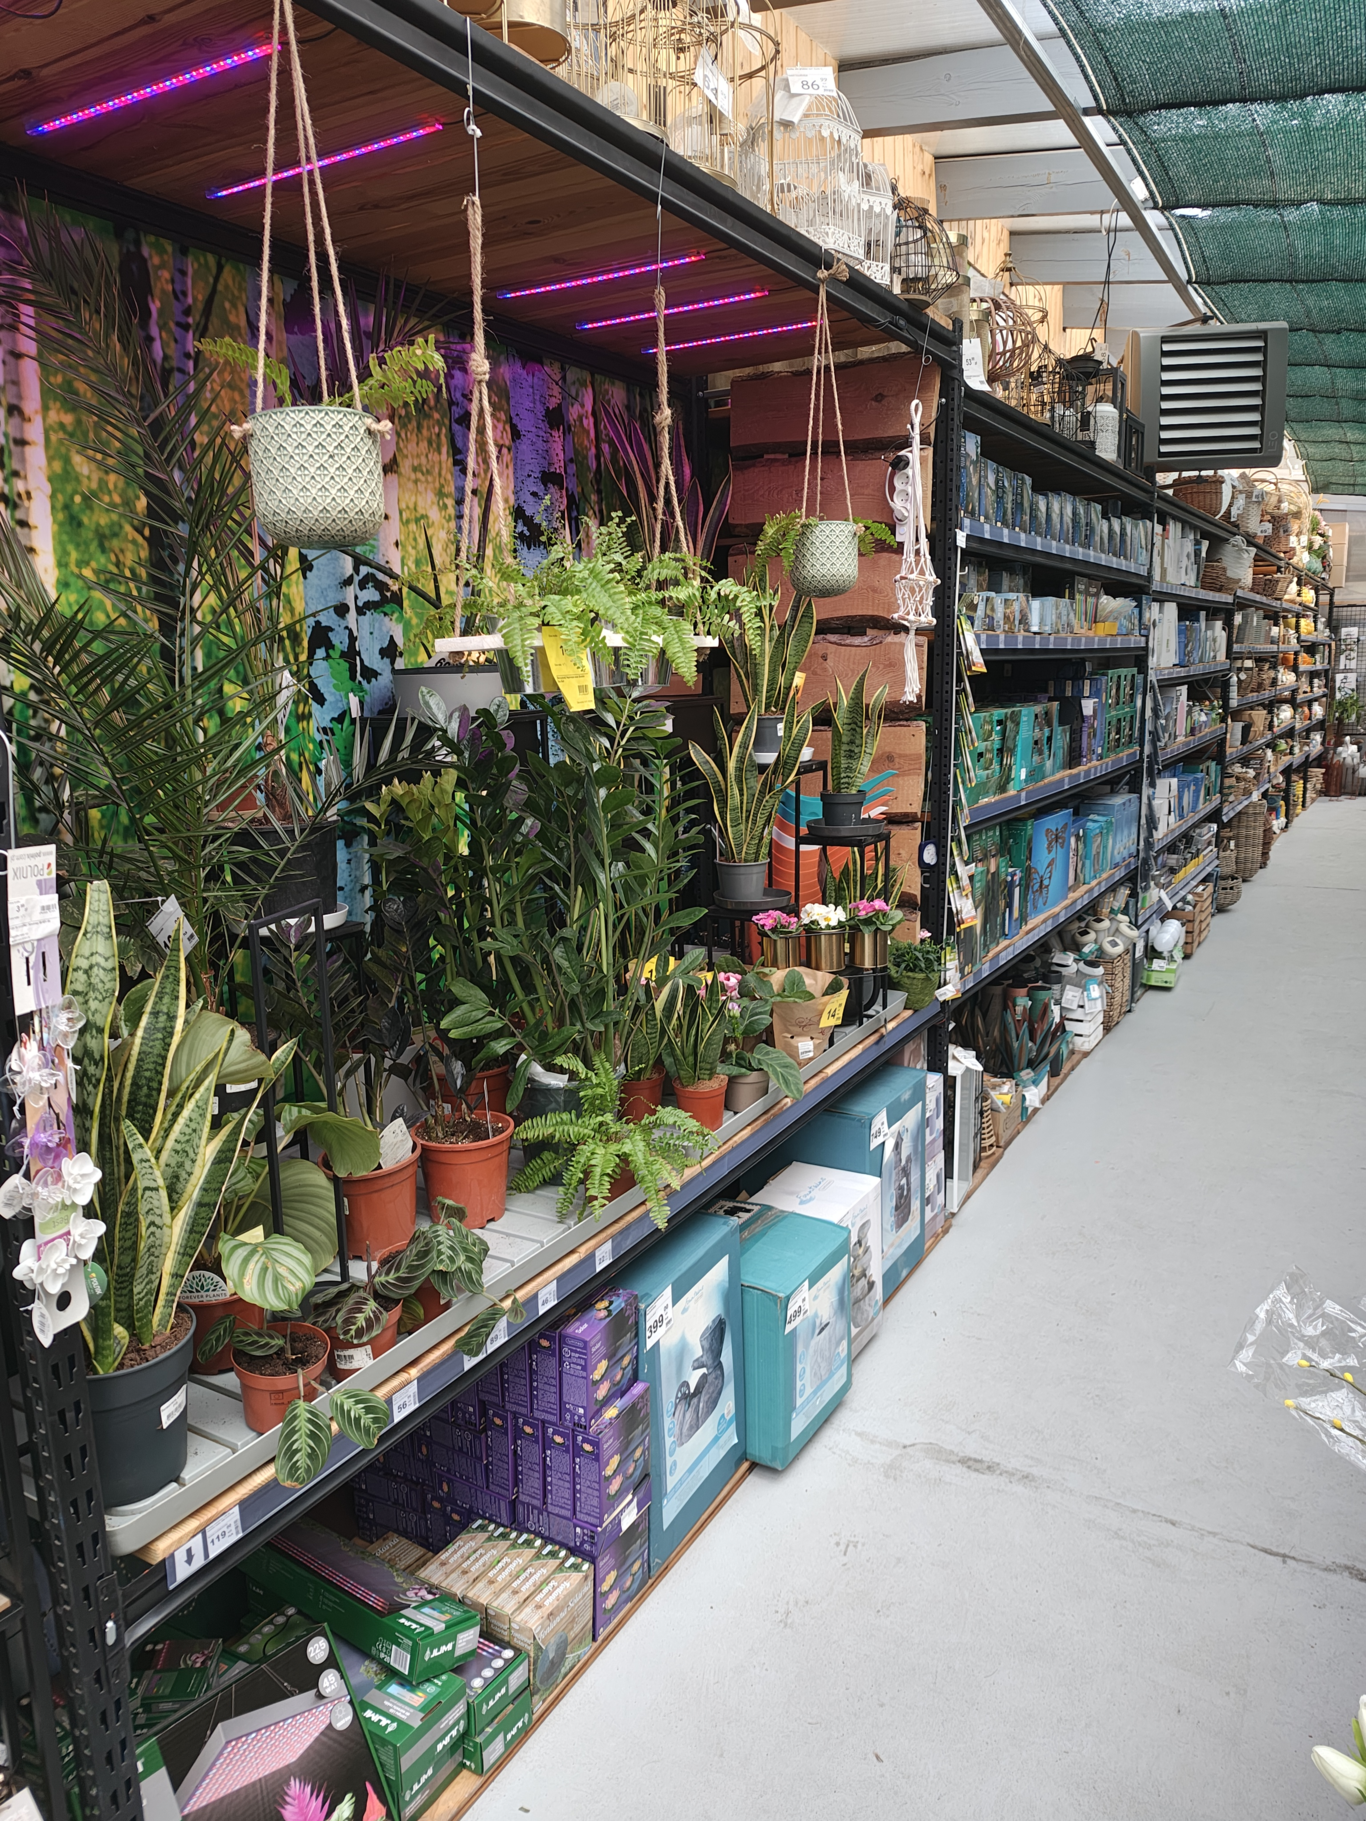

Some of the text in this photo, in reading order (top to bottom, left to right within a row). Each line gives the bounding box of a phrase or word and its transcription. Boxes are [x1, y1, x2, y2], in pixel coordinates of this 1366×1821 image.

[800, 79, 821, 91] 86
[1268, 430, 1279, 451] LEO
[12, 863, 45, 881] POLNIX
[826, 1007, 838, 1021] 14
[52, 1214, 69, 1230] Best
[786, 1304, 802, 1326] 499
[647, 1313, 664, 1339] 399
[489, 1333, 499, 1346] 89
[397, 1401, 408, 1414] 56
[209, 1530, 227, 1546] 119
[375, 1537, 400, 1556] olarna
[487, 1556, 511, 1578] Solarna
[496, 1556, 524, 1582] Fontanna
[511, 1566, 535, 1588] Solarna
[520, 1567, 548, 1593] Fontanna
[534, 1580, 558, 1602] Solarna
[543, 1581, 571, 1607] Fontanna
[308, 1640, 326, 1659] 225
[315, 1650, 325, 1661] LED
[430, 1642, 454, 1658] JUMI
[322, 1673, 336, 1687] 45
[325, 1682, 338, 1694] WAT
[487, 1684, 507, 1710] JUMI
[363, 1709, 392, 1727] JUMI
[436, 1725, 459, 1753] JUMI
[506, 1718, 524, 1743] JUMI
[411, 1766, 433, 1795] JUMI
